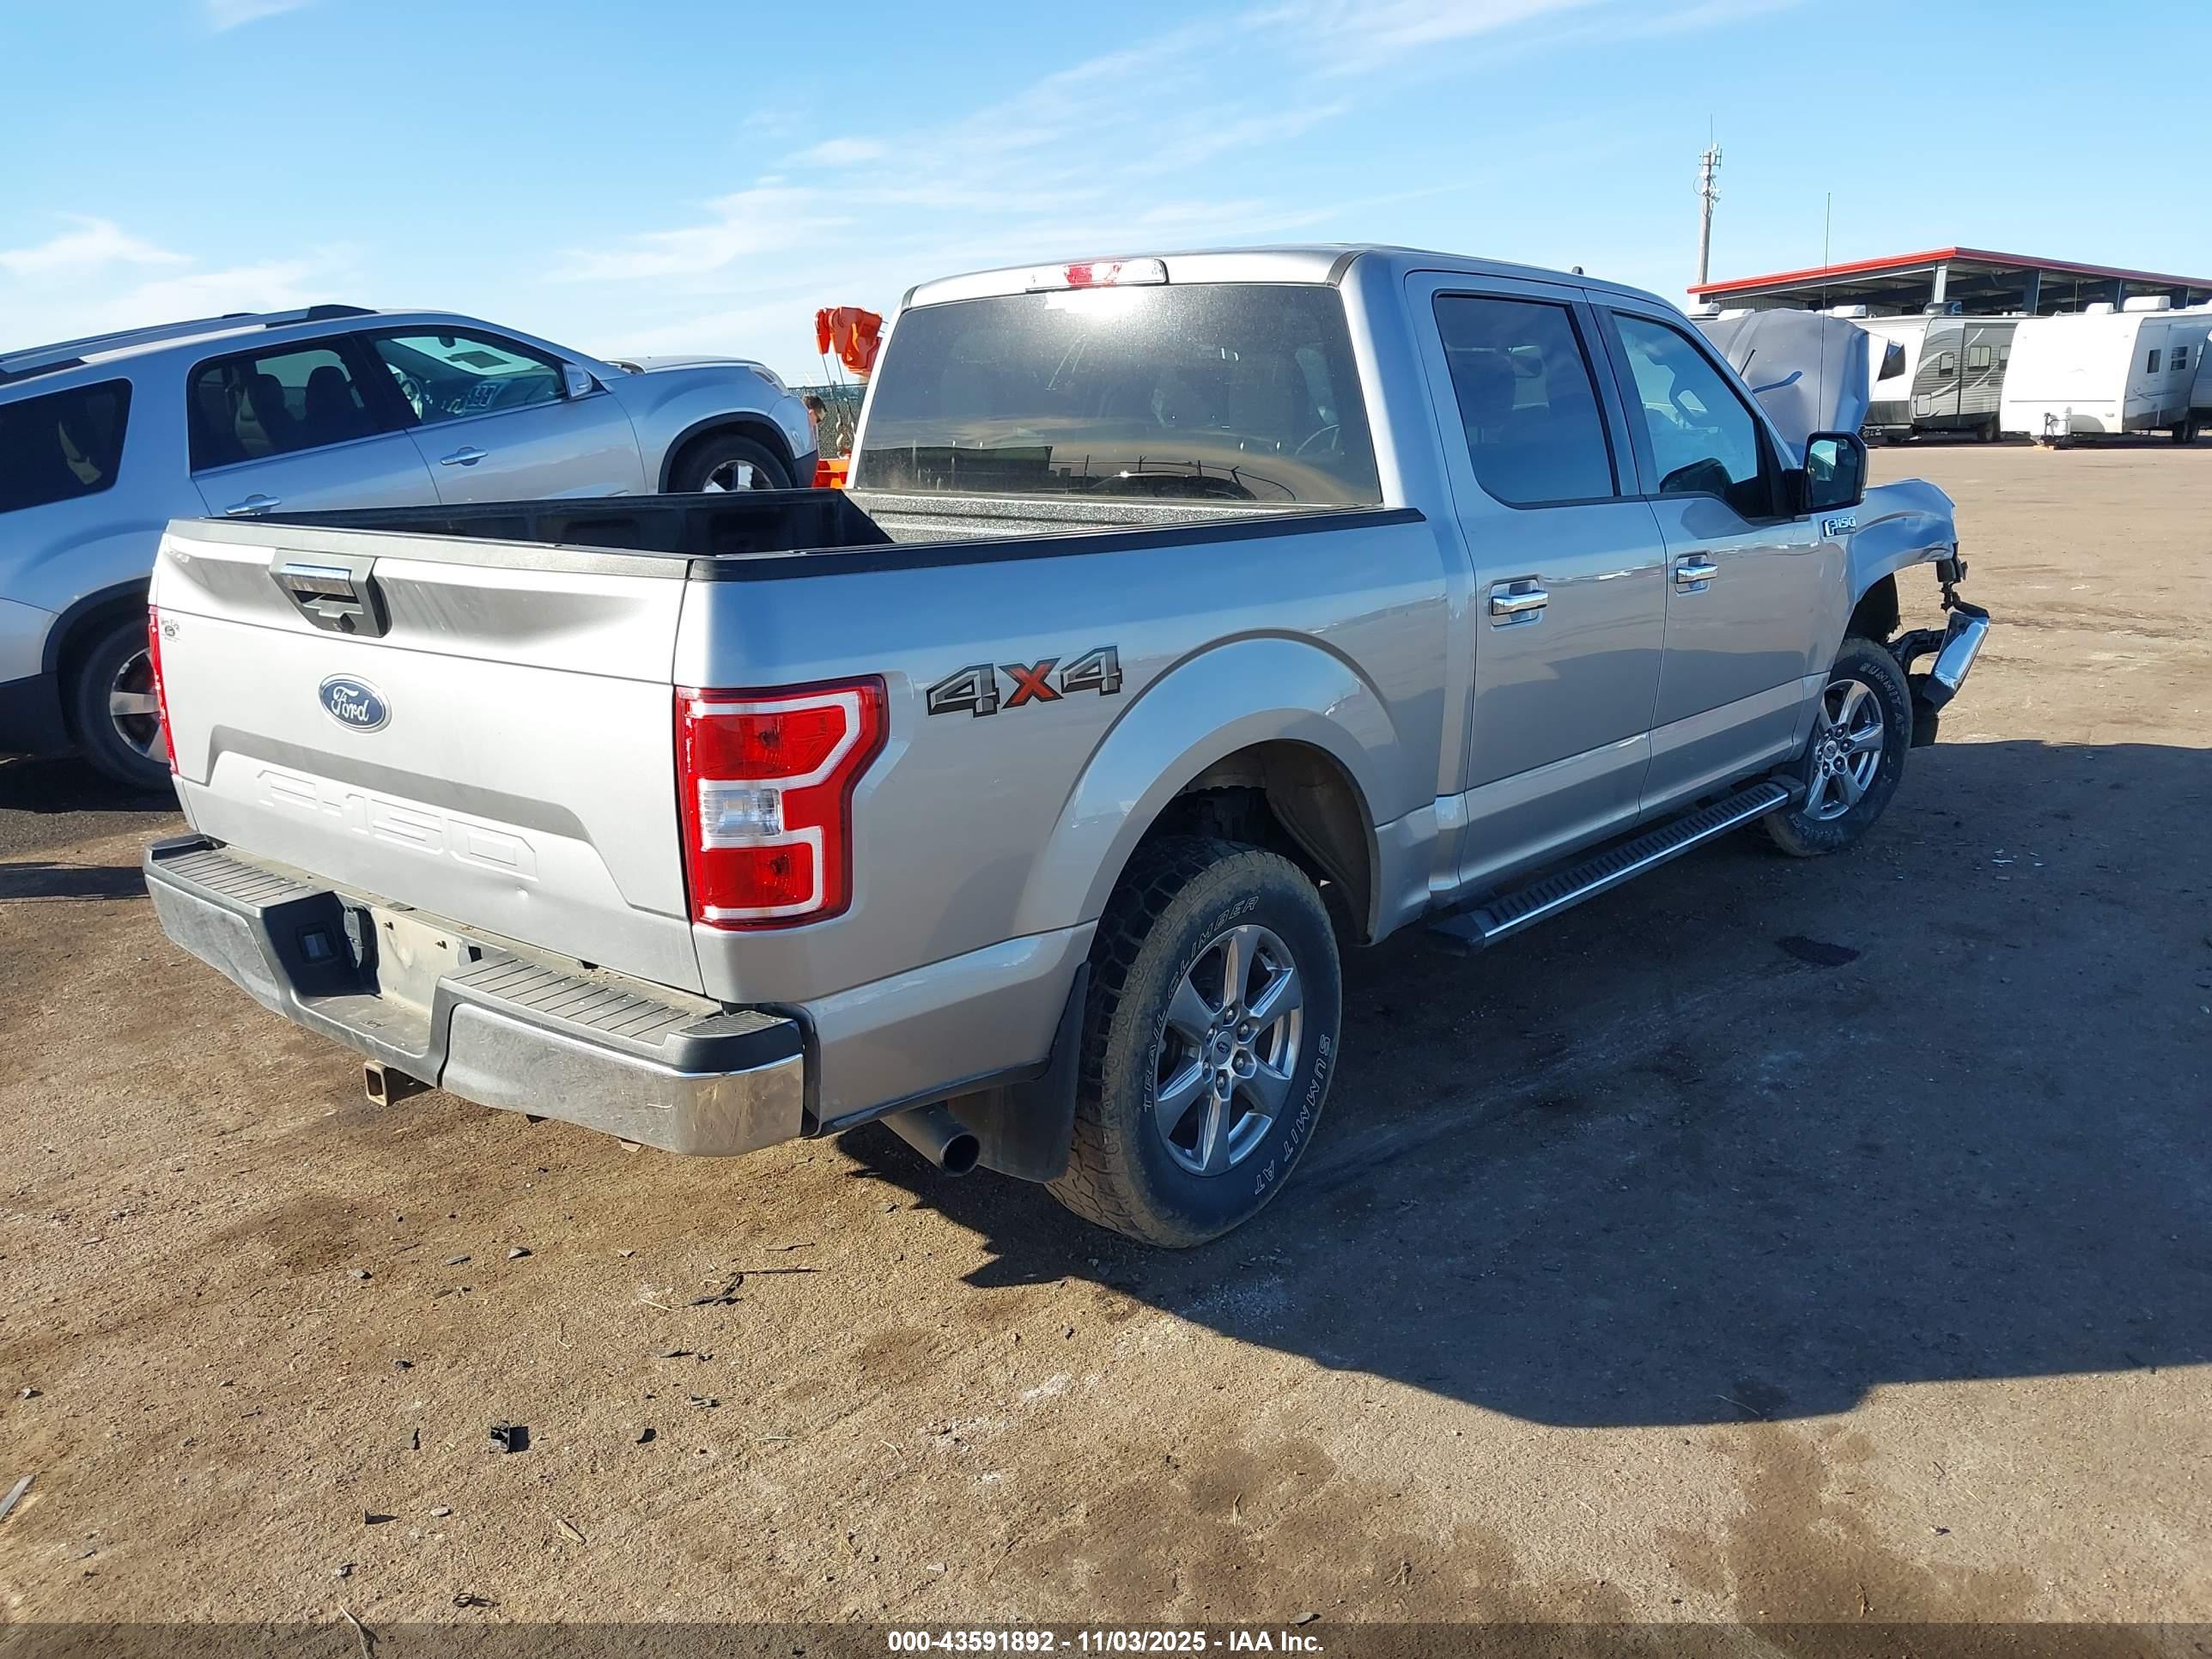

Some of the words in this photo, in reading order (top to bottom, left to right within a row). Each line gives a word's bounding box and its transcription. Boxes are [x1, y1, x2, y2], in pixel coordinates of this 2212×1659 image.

[331, 685, 370, 722] Ford
[257, 769, 539, 883] F-150
[1143, 1009, 1168, 1114] TRAIL
[1168, 896, 1260, 1000] CLIMBER
[1284, 1033, 1332, 1164] SUMMIT
[1254, 1158, 1275, 1195] AT
